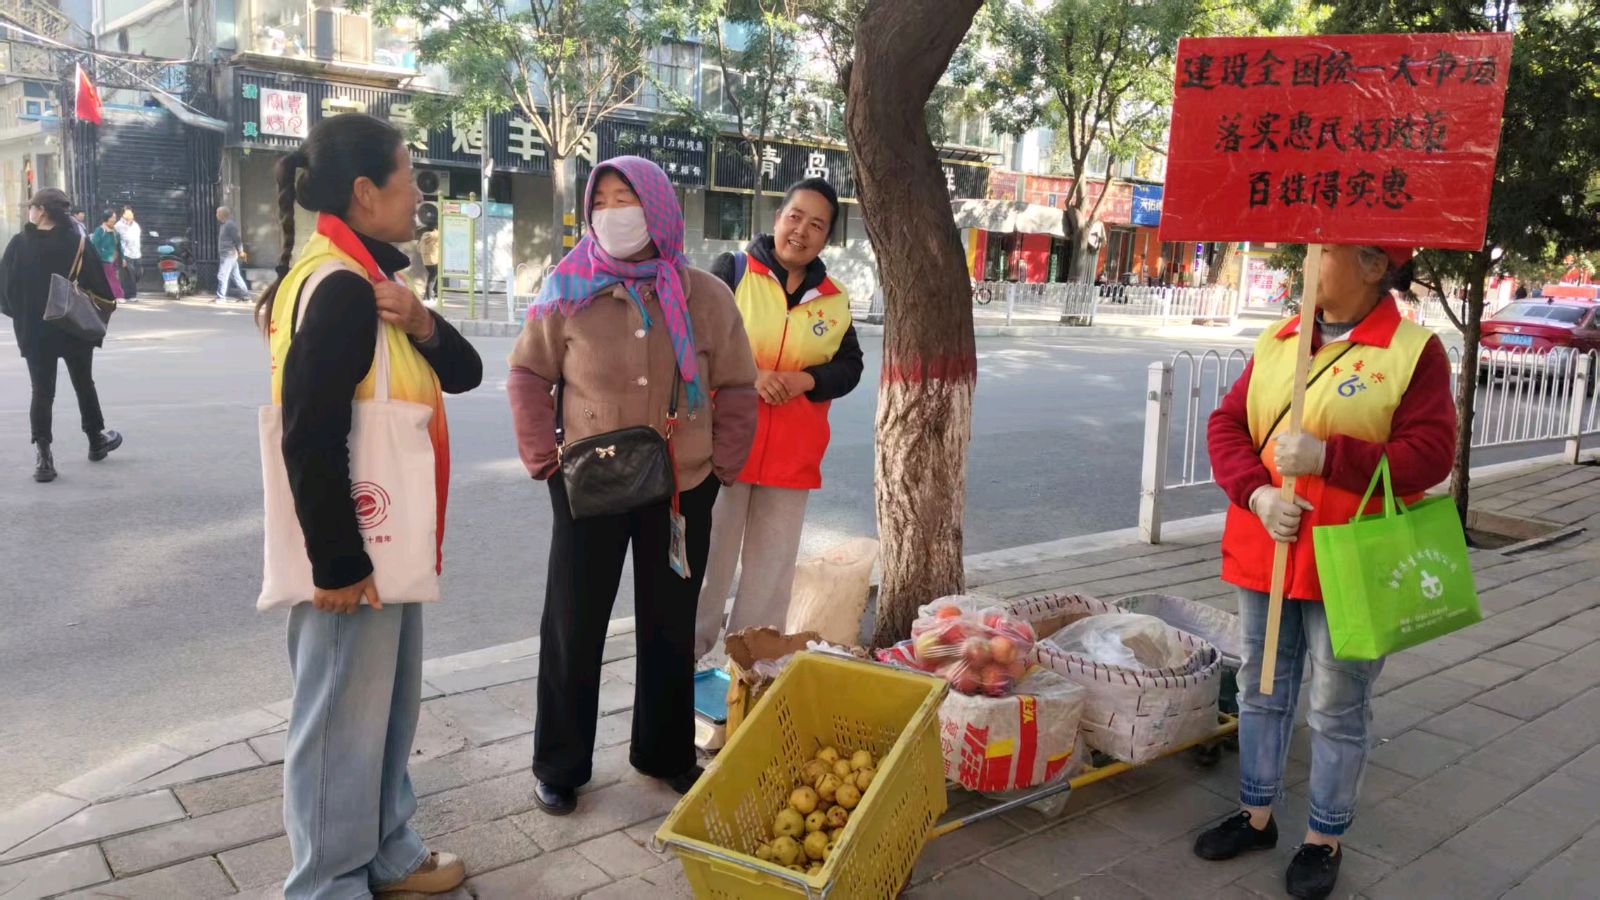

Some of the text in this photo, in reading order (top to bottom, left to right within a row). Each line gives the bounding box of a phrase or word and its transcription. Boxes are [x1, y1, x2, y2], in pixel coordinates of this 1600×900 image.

[1180, 49, 1497, 90] 建设全国统一大市场
[1215, 110, 1449, 154] 落实惠民好政策
[1249, 166, 1414, 209] 百姓得实惠
